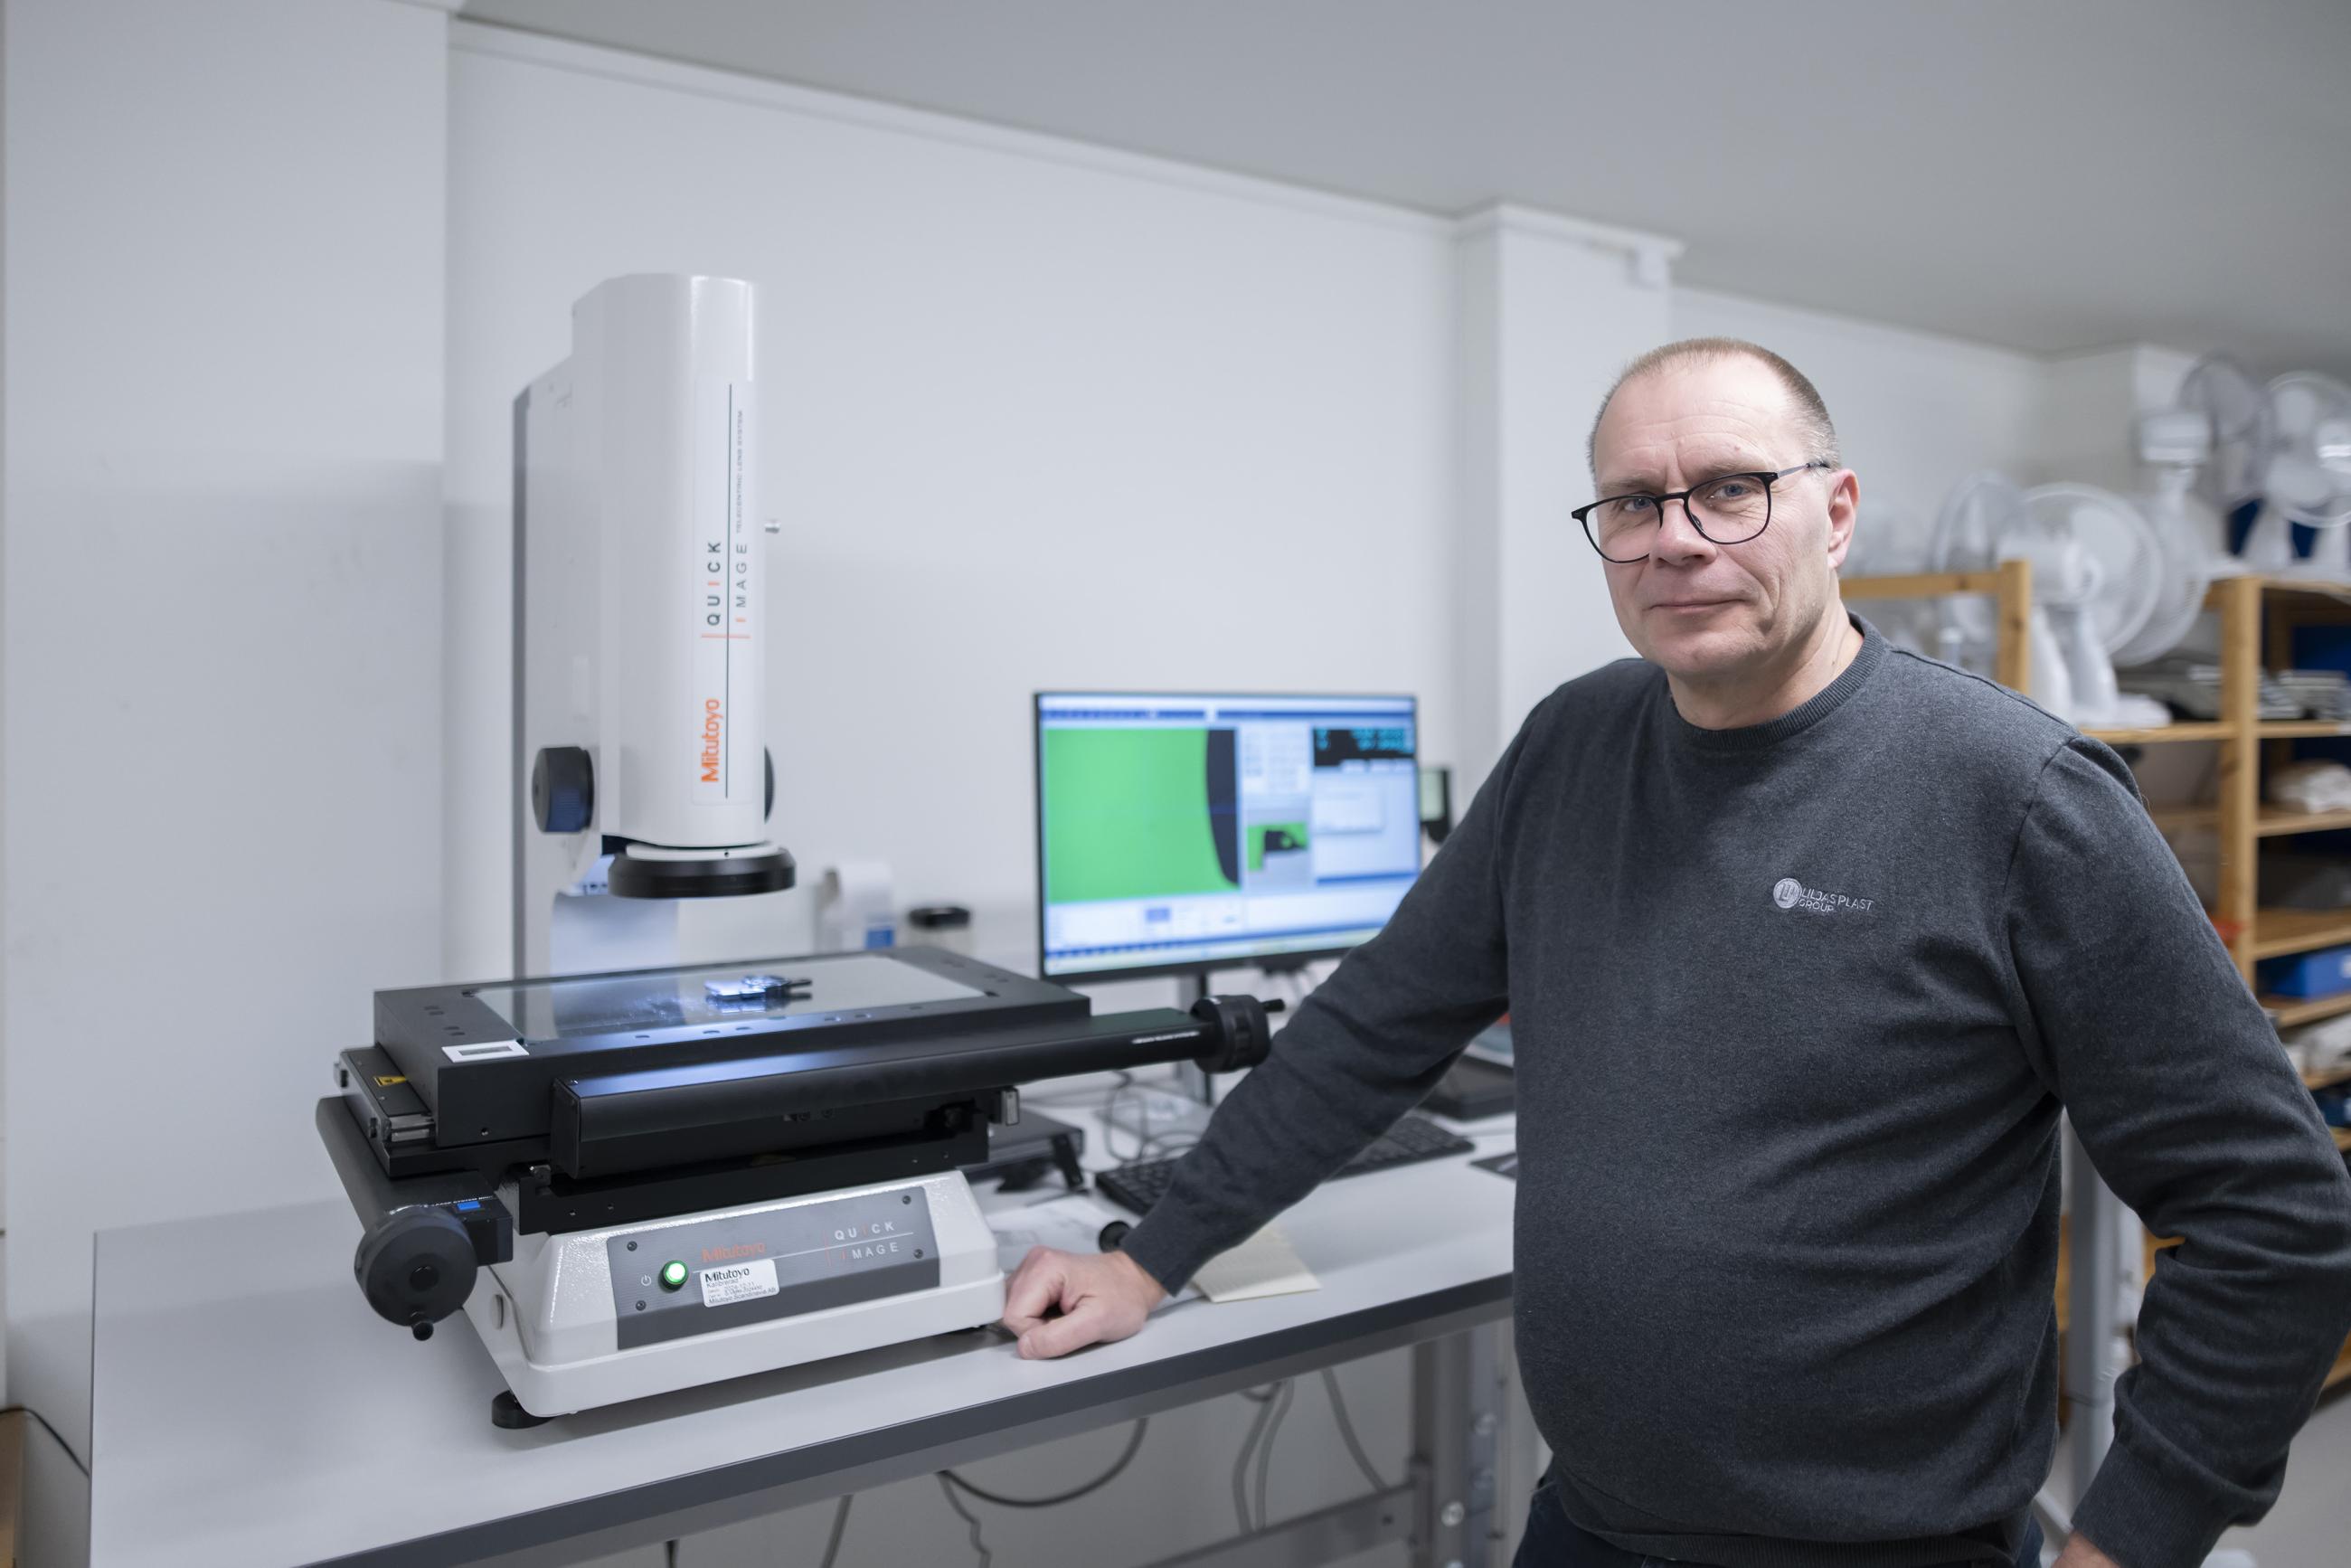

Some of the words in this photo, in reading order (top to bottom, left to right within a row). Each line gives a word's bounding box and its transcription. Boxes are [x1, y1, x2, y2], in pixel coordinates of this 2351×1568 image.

[707, 542, 721, 626] QUICK
[735, 543, 748, 623] IMAGE
[701, 698, 722, 783] Mitutoyo
[1799, 899, 1834, 913] GROUP
[1837, 894, 1874, 911] PLAST
[835, 1221, 895, 1241] QUICK
[702, 1242, 765, 1262] Mitutoyo
[840, 1242, 899, 1261] IMAGE
[705, 1268, 750, 1282] Mitutoyo
